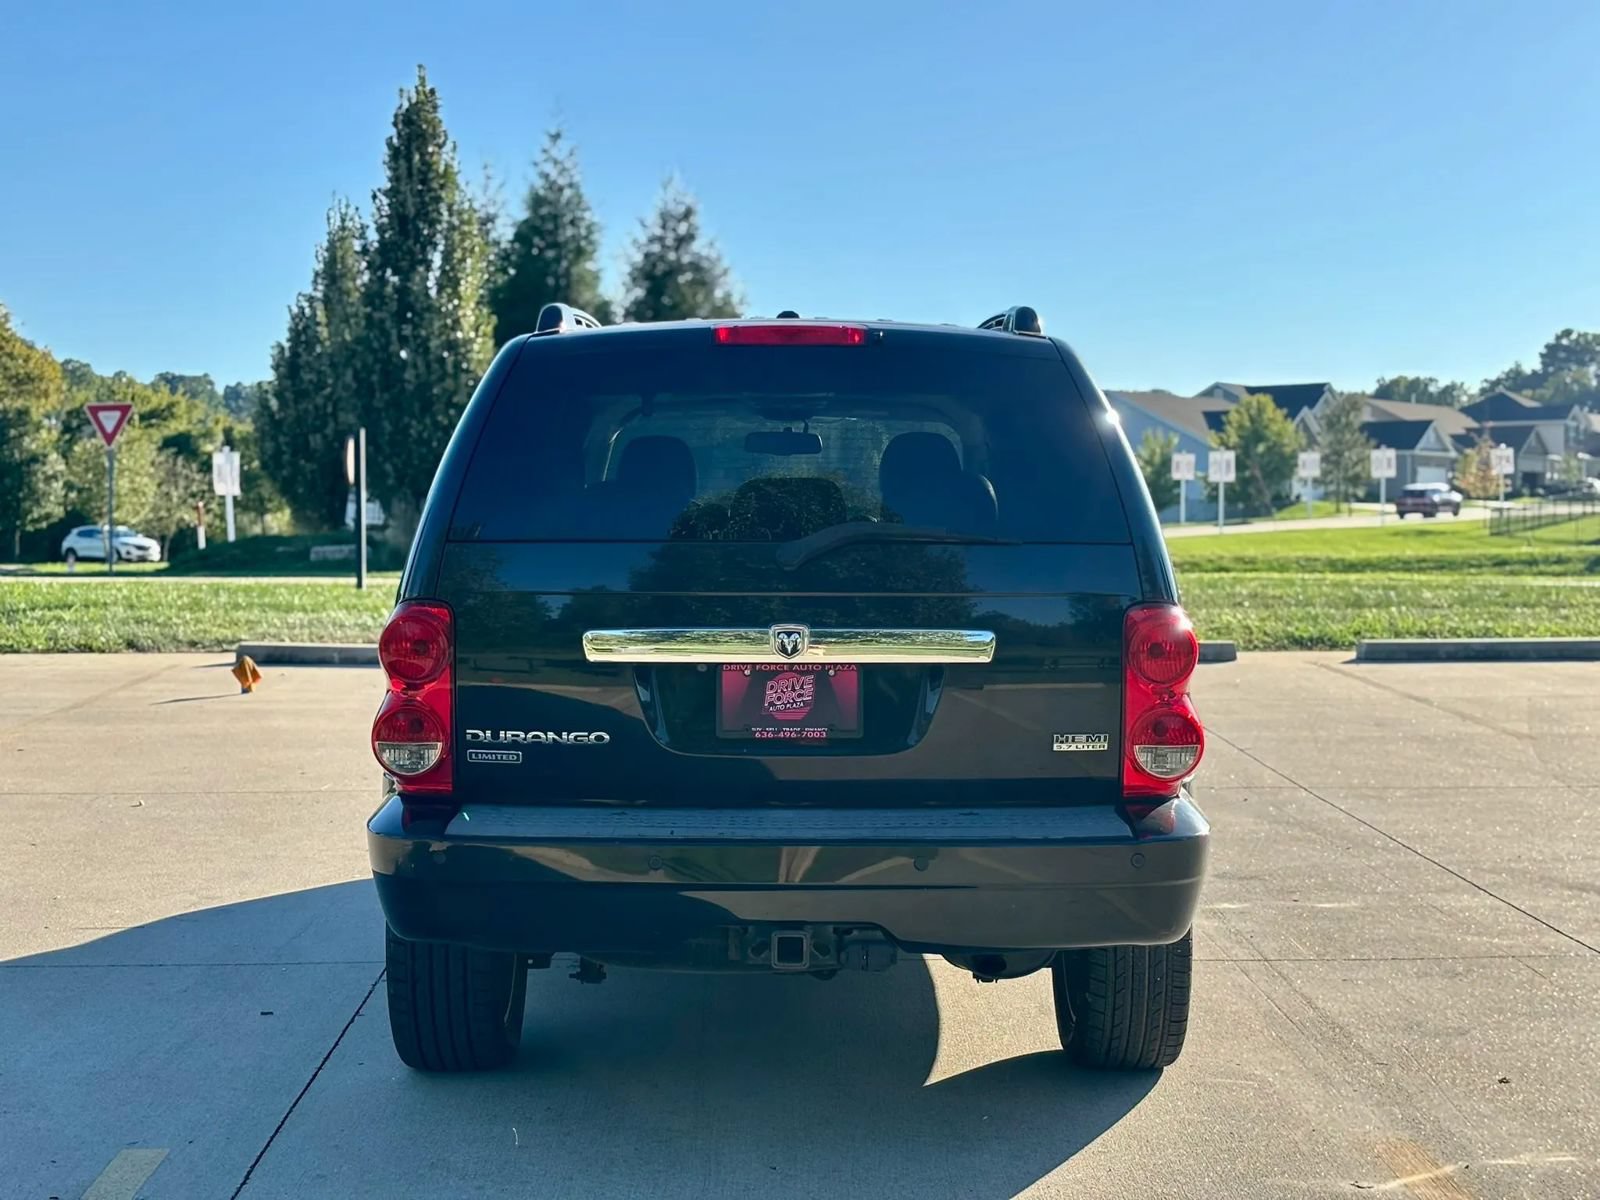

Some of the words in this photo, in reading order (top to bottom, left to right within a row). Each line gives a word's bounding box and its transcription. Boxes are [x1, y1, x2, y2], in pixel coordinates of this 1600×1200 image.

[766, 674, 814, 694] DRIVE
[764, 687, 814, 706] FORCE
[769, 704, 785, 712] AUTO
[786, 701, 804, 709] PLAZA
[465, 729, 611, 745] DURANGO
[1054, 734, 1109, 744] HEMI
[471, 753, 518, 761] LIMITED
